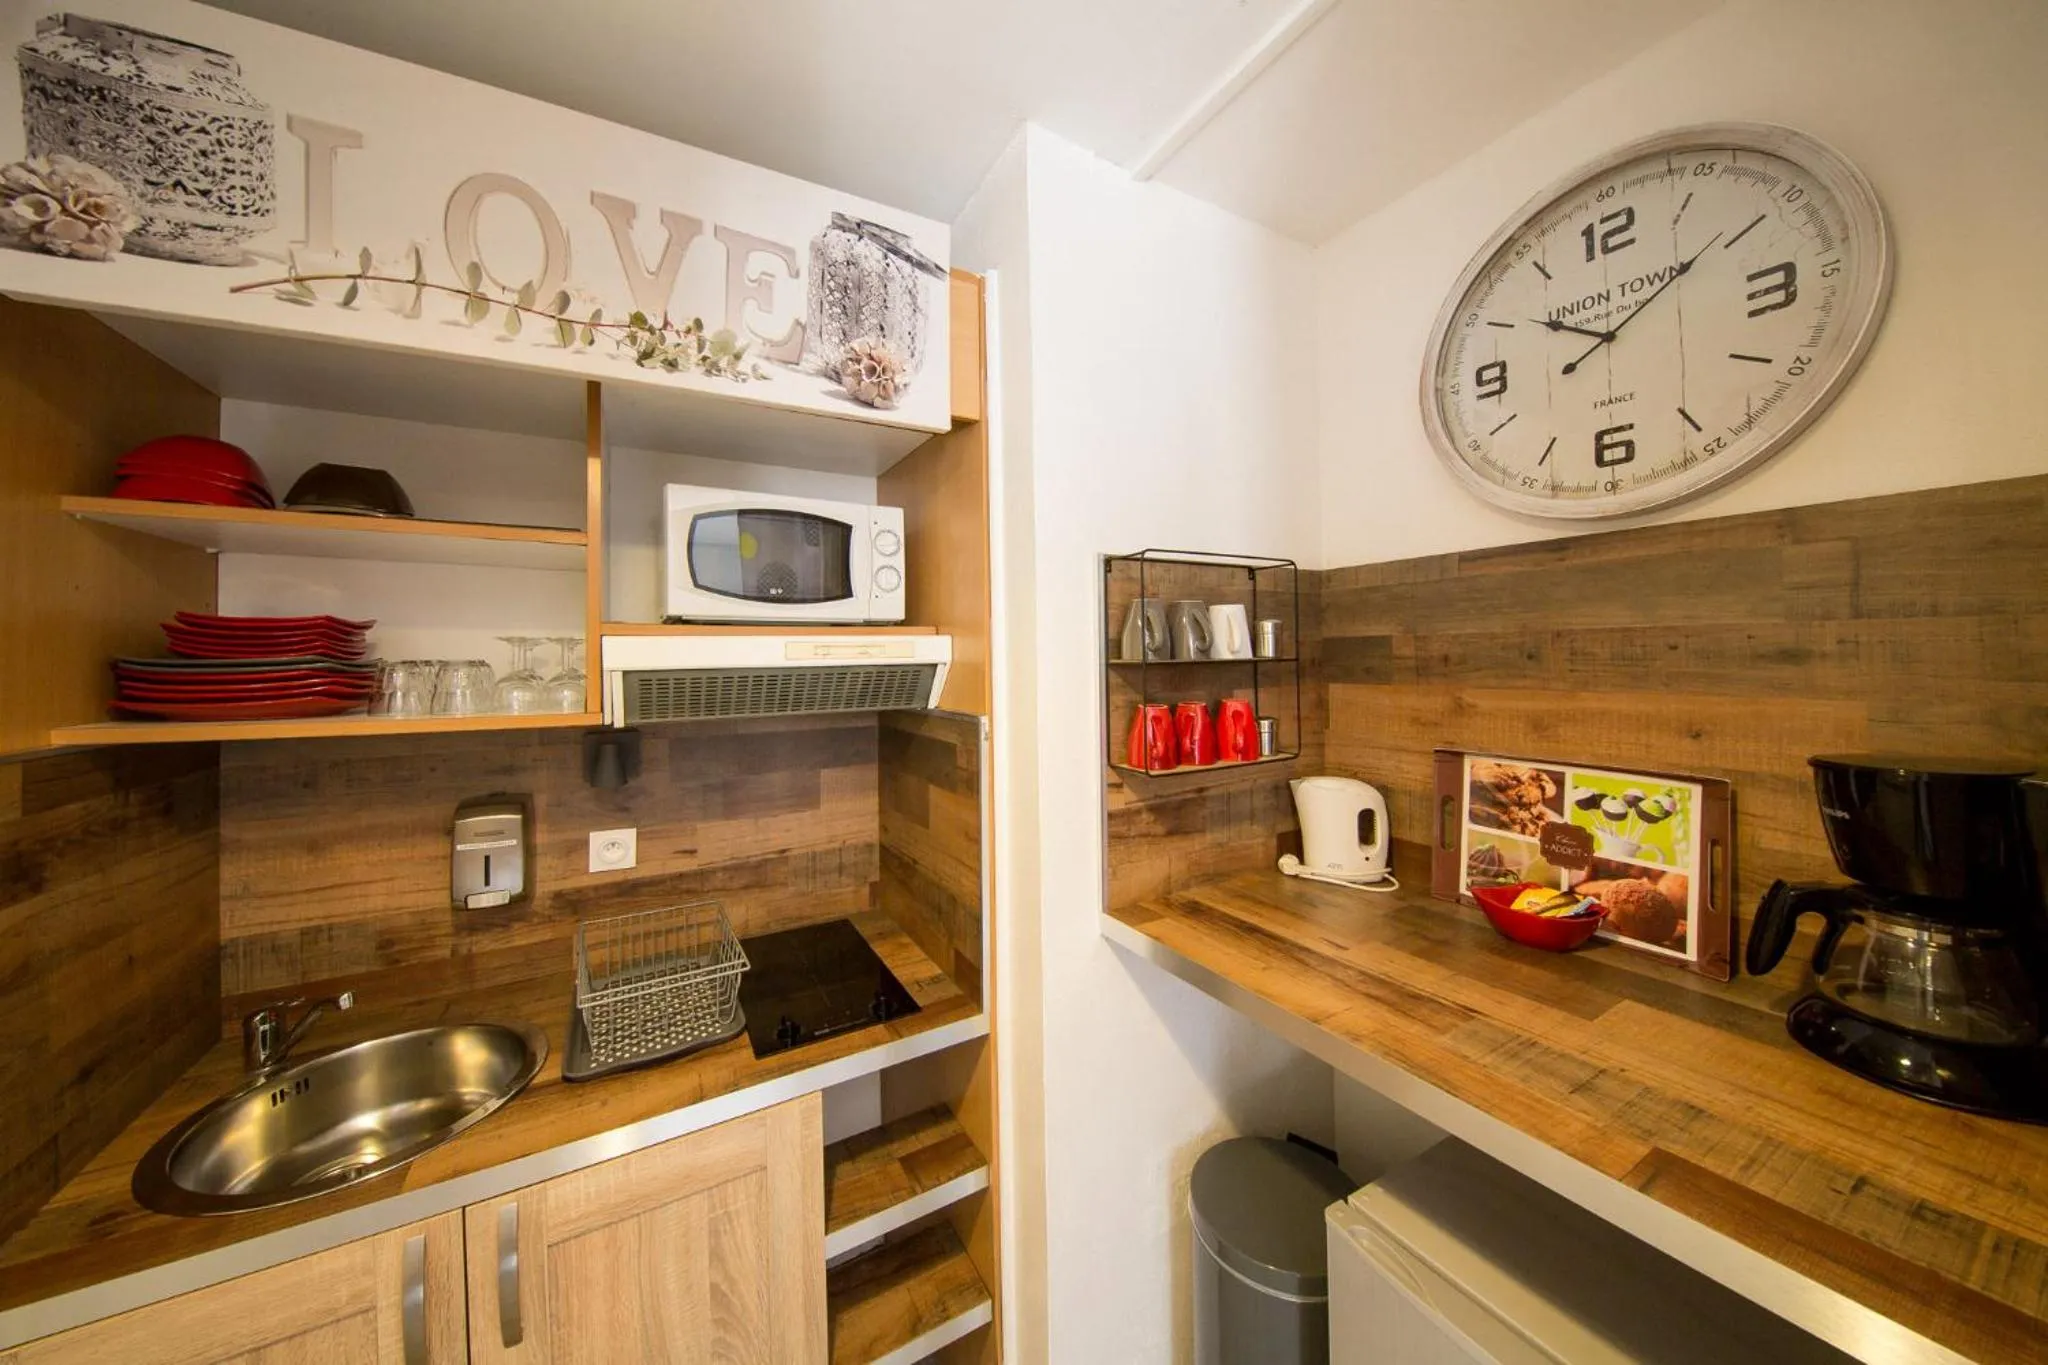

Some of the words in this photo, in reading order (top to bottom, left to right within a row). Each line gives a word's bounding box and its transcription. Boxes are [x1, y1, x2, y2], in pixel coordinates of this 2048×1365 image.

[1693, 161, 1718, 177] 05
[1595, 185, 1616, 203] 60
[1781, 184, 1804, 203] 10
[1580, 206, 1637, 263] 12
[1515, 242, 1532, 260] 55
[1821, 259, 1841, 278] 15
[1548, 288, 1611, 322] UNION
[1618, 261, 1688, 298] TOWN
[1746, 261, 1798, 319] 3
[1465, 312, 1480, 328] 50
[1787, 355, 1812, 377] 20
[1475, 359, 1508, 401] 9
[1593, 391, 1636, 409] FRANCE
[1594, 422, 1636, 469] 6
[1703, 436, 1728, 457] 25
[1520, 476, 1539, 490] 35
[1603, 478, 1624, 493] 30
